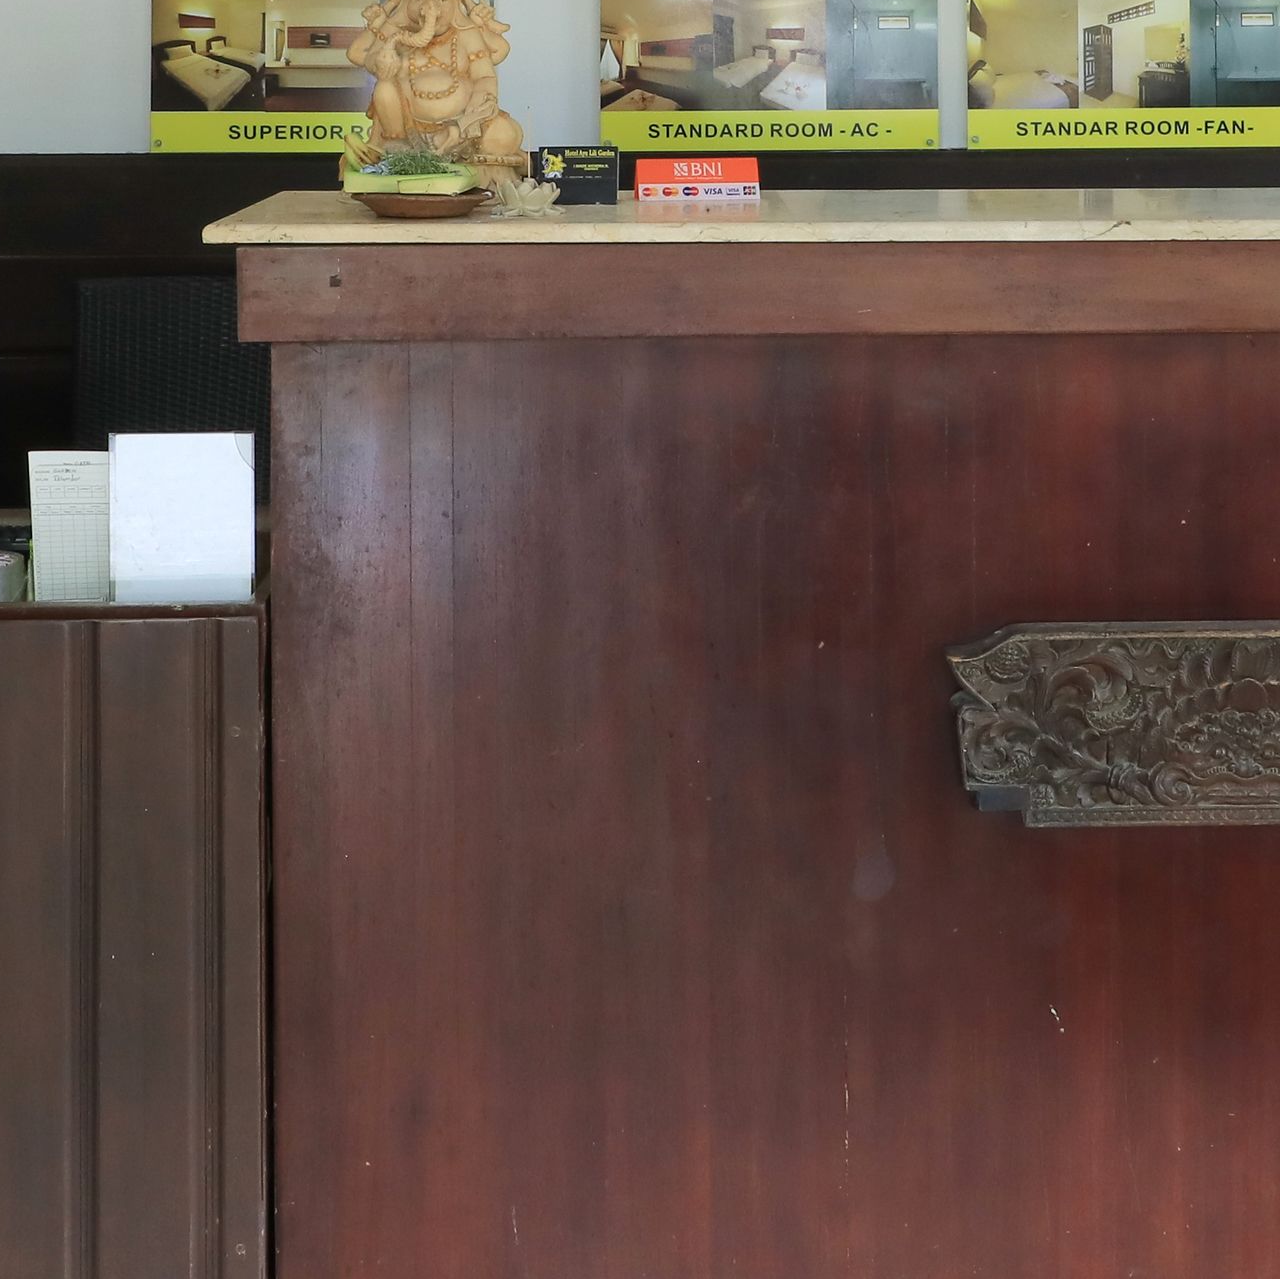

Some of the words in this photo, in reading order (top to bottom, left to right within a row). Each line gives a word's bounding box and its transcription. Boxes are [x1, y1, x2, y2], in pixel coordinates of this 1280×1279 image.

[227, 123, 344, 141] SUPERIOR
[648, 123, 764, 139] STANDARD
[770, 123, 833, 138] ROOM
[850, 122, 879, 137] AC
[1016, 121, 1118, 137] STANDAR
[1125, 120, 1189, 136] ROOM
[1196, 120, 1254, 135] -FAN-
[690, 162, 723, 177] BNI
[703, 187, 723, 195] VISA
